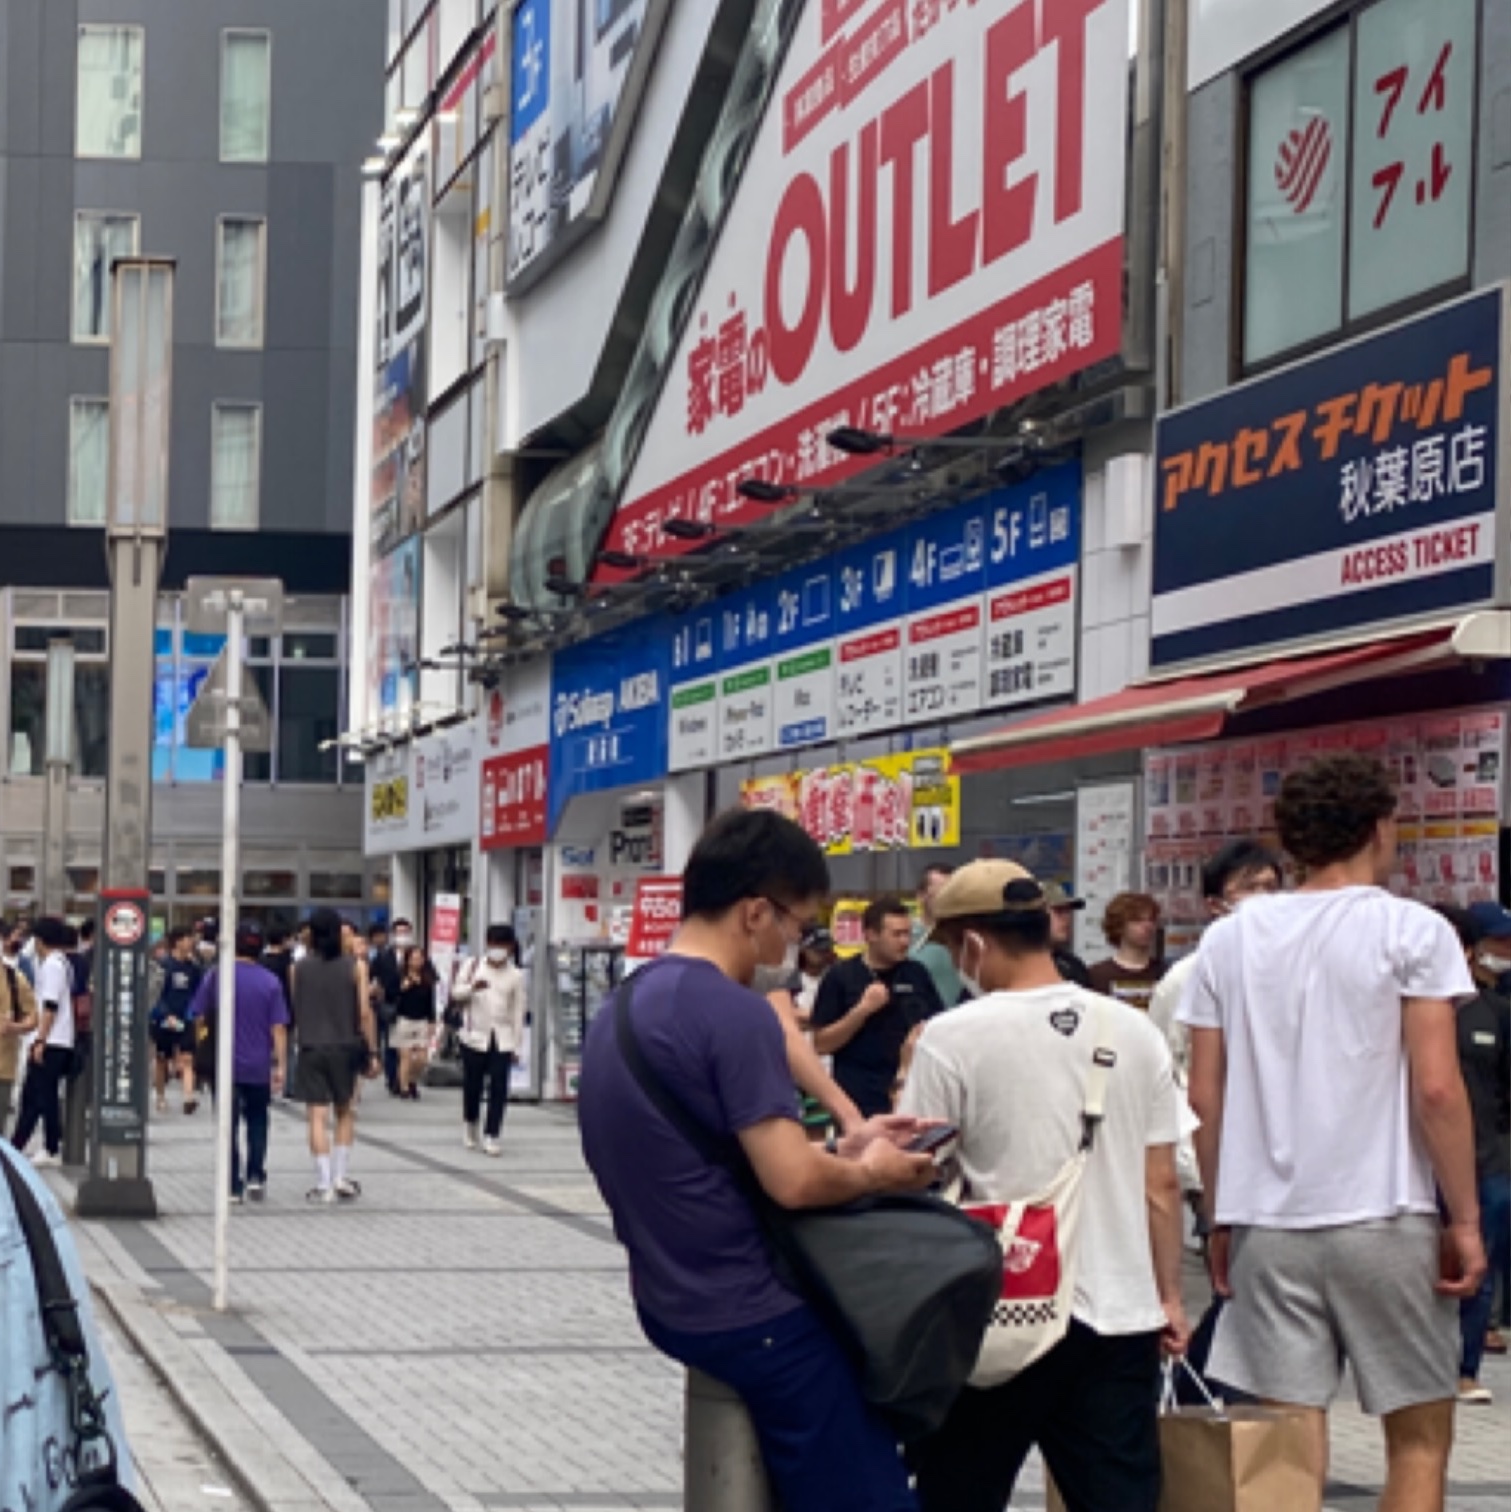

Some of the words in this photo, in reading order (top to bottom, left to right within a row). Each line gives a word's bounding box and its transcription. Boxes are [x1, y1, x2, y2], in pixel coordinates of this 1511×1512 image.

[763, 0, 1107, 386] OUTLET
[1161, 409, 1308, 512] アクセス
[1312, 352, 1494, 461] チケット
[1339, 424, 1487, 524] 秋葉原店
[910, 538, 937, 588] 4F
[990, 508, 1021, 564] 5F
[1341, 539, 1409, 585] ACCESS
[1412, 522, 1481, 569] TICKET
